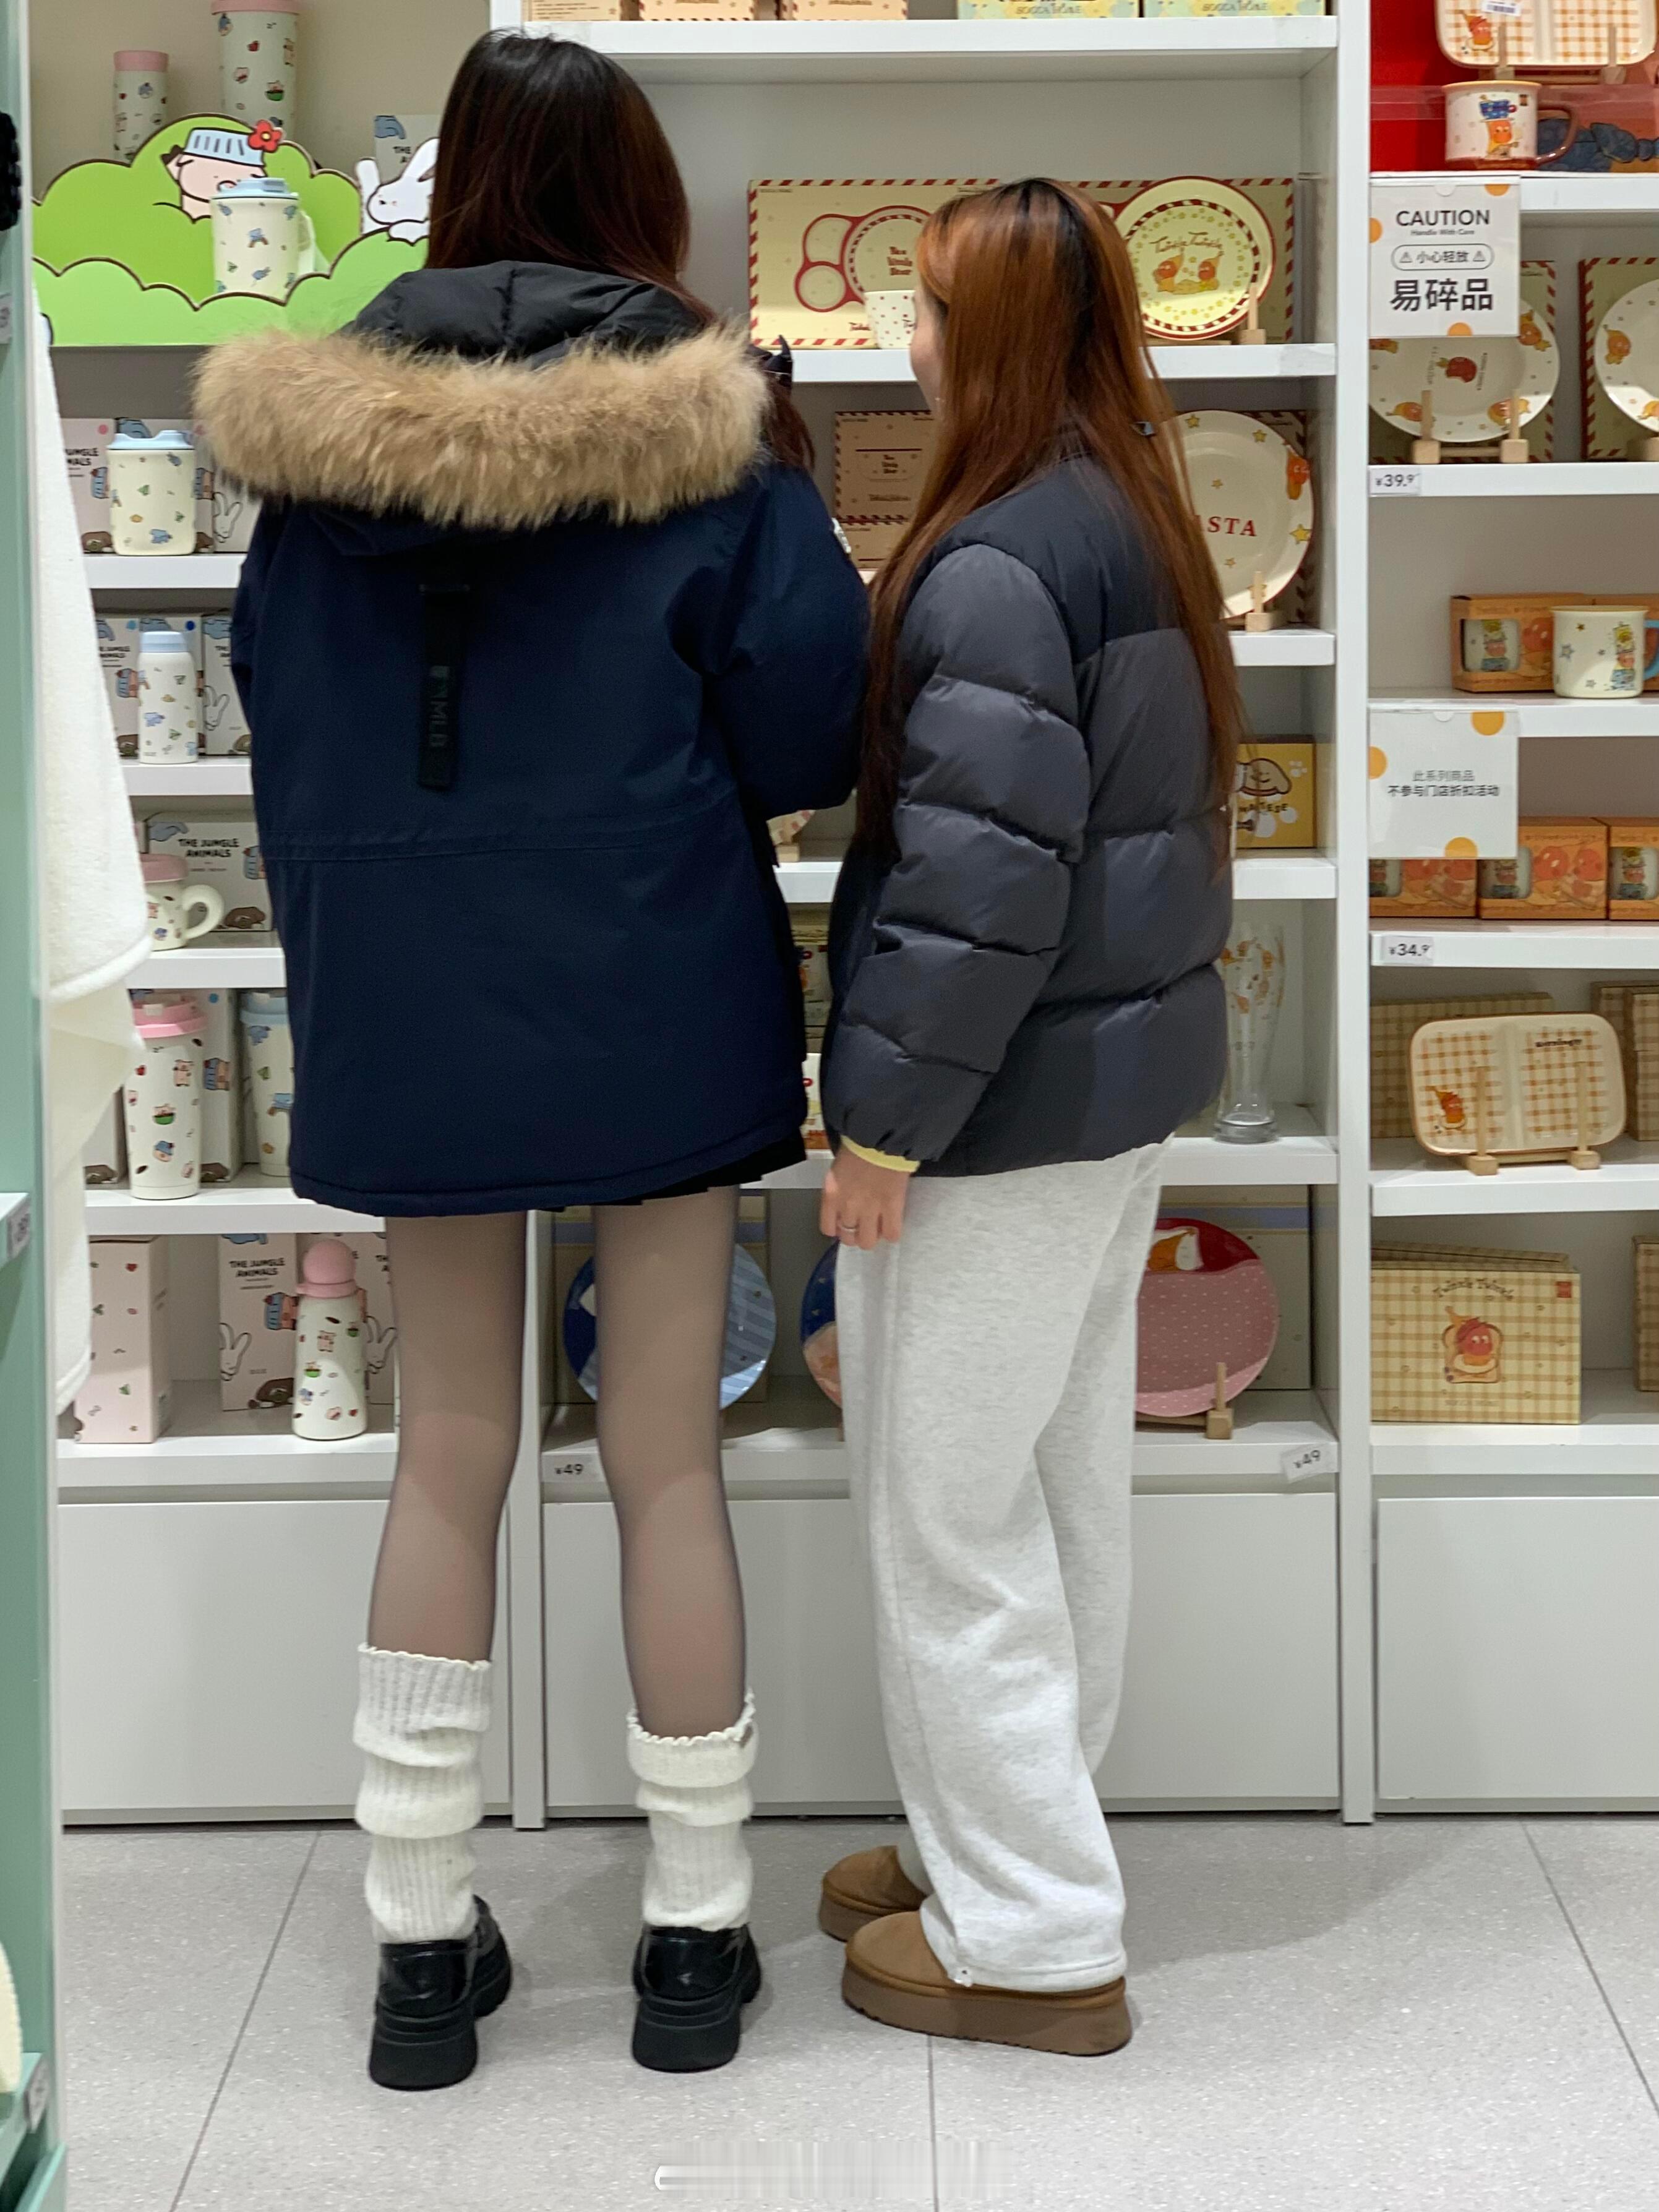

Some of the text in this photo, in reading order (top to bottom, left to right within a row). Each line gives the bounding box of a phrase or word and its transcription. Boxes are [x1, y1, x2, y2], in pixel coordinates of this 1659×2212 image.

[1396, 210, 1490, 226] CAUTION
[1416, 250, 1470, 264] 小心轻放
[1390, 278, 1493, 311] 易碎品
[1413, 769, 1475, 782] 此系列商品
[1387, 784, 1500, 797] 不参与门店折扣活动
[178, 838, 239, 847] THE JUNGLE
[186, 849, 231, 857] ANIMALS
[235, 1267, 278, 1277] ANIMALS
[554, 1464, 584, 1475] ¥49
